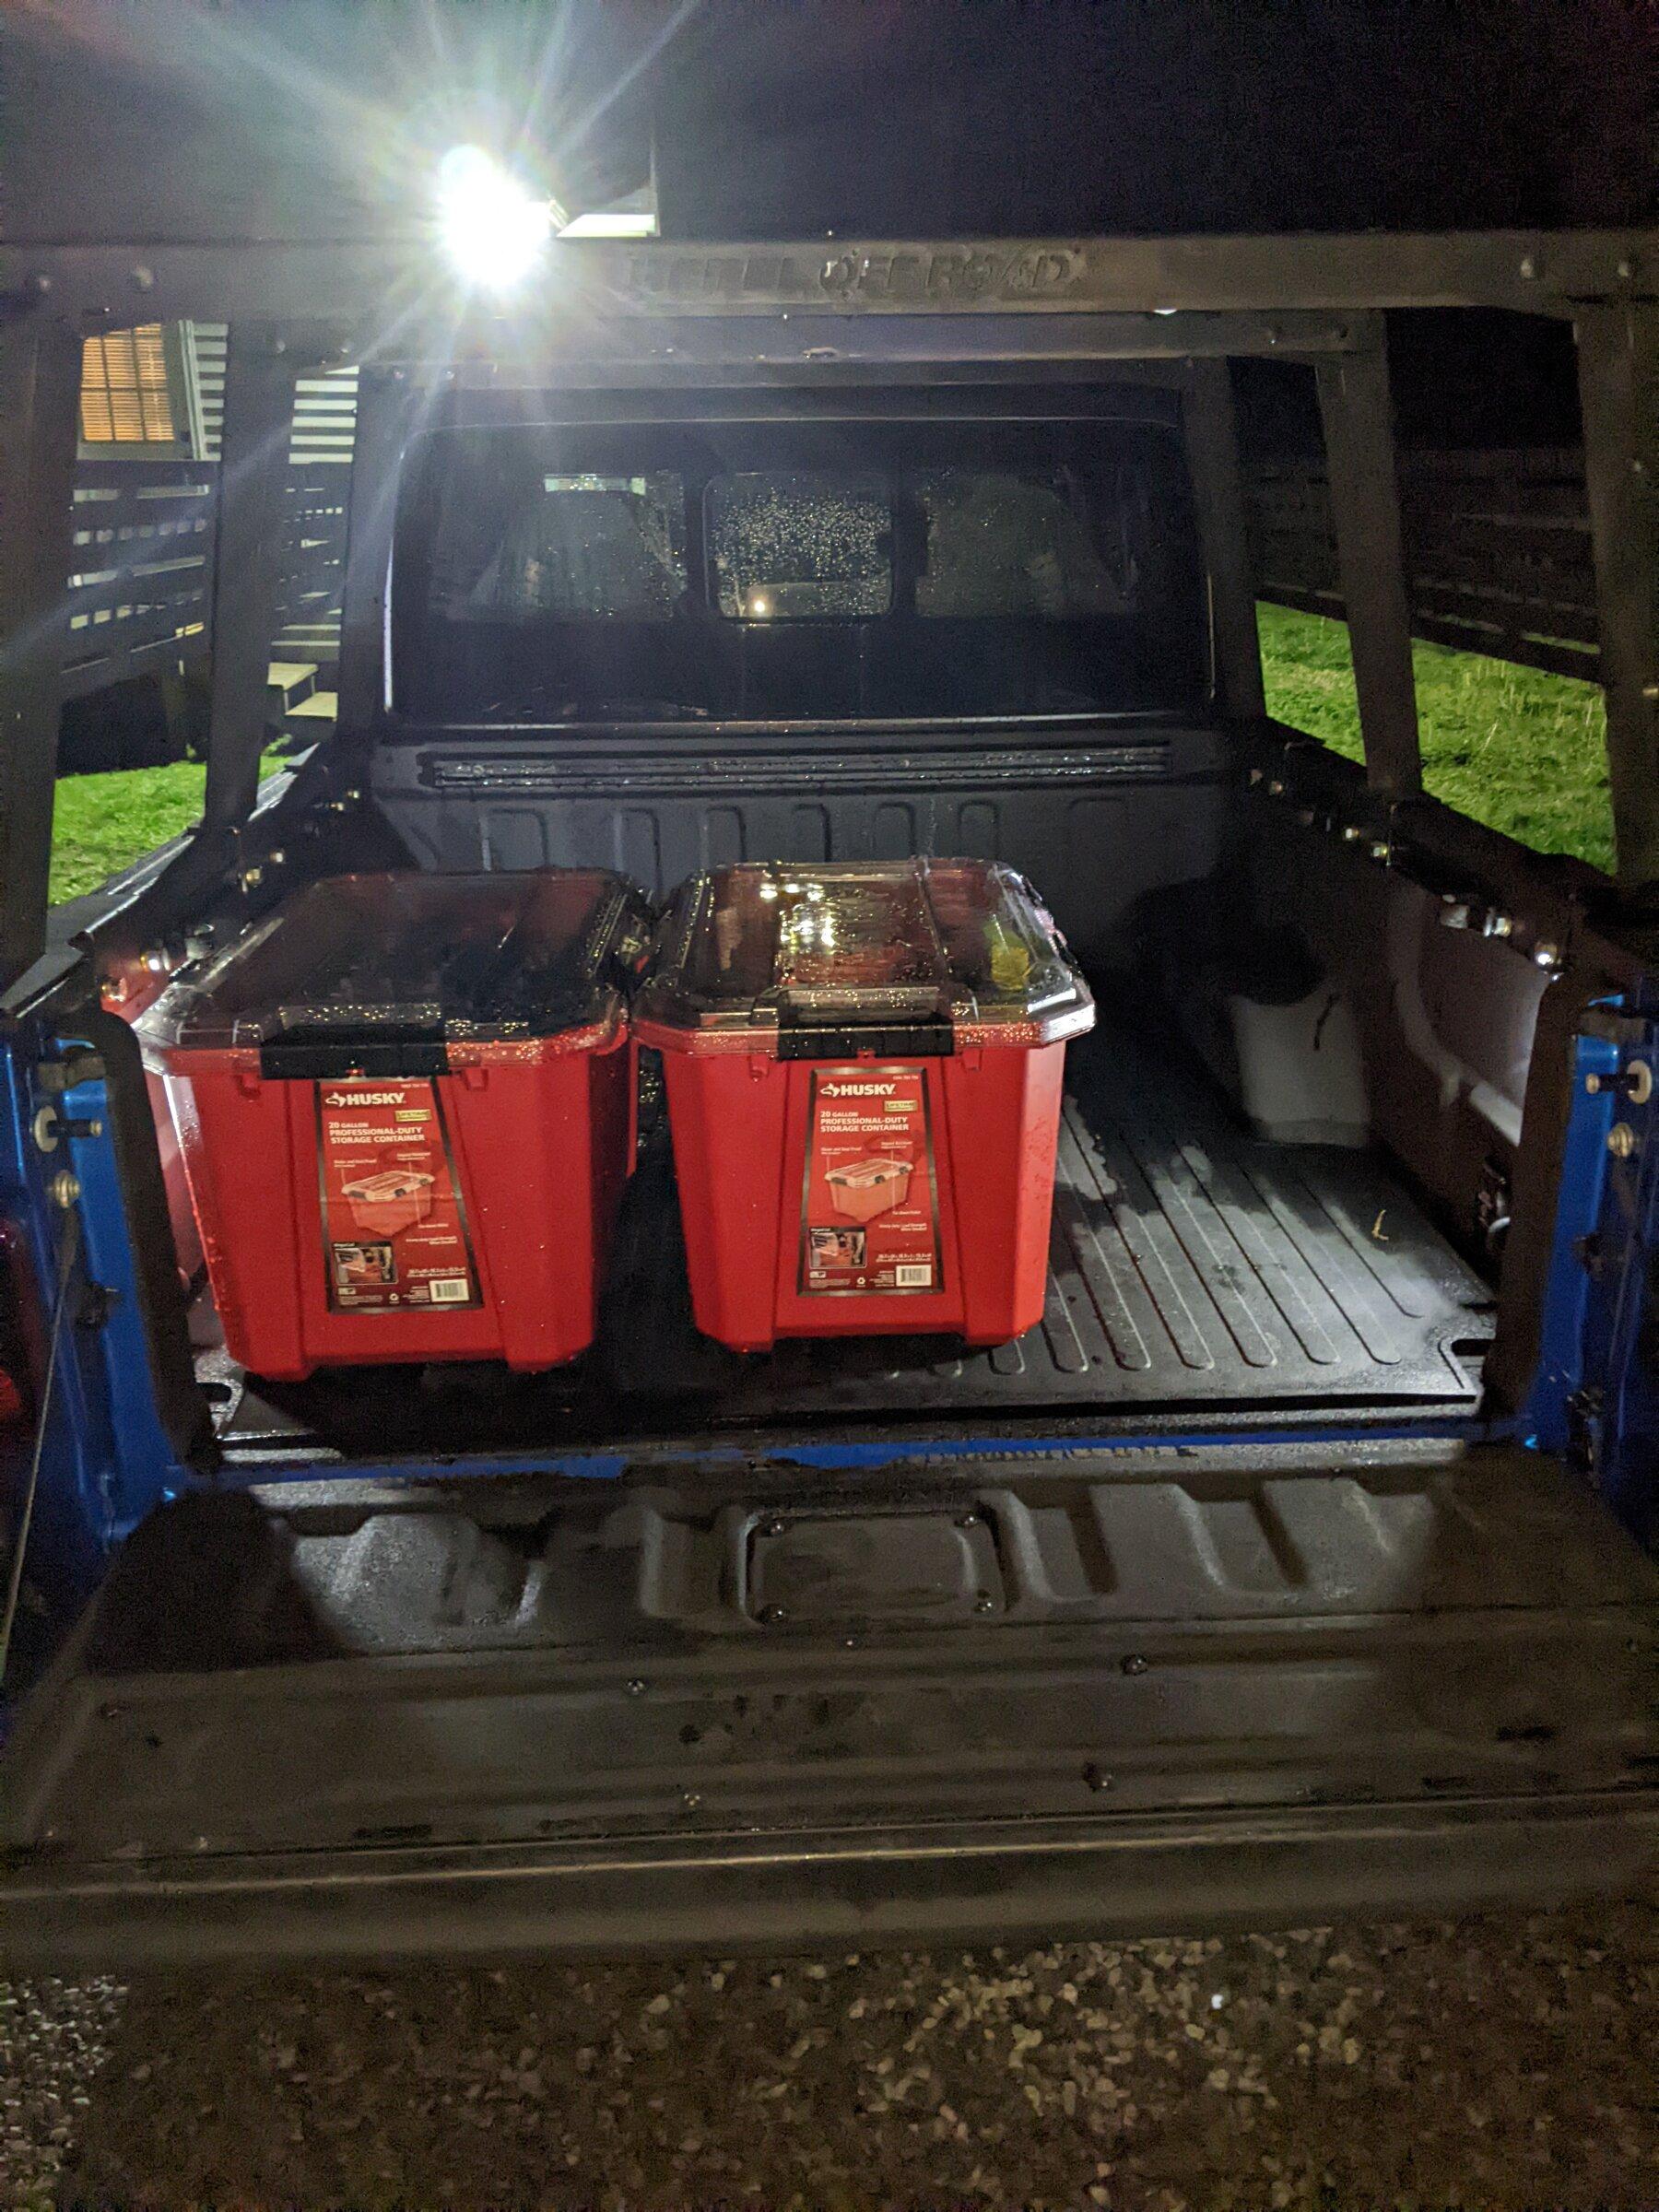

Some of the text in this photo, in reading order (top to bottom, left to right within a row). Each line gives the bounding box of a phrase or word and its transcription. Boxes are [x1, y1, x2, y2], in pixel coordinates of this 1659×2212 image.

[841, 1083, 897, 1097] HUSKY
[346, 1092, 406, 1106] HUSKY
[820, 1116, 908, 1125] PROFESSIONAL-DUTY
[329, 1126, 423, 1136] PROFESSIONAL-DUTY
[820, 1124, 910, 1133] STORAGE CONTAINER
[373, 1135, 425, 1143] CONTAINER
